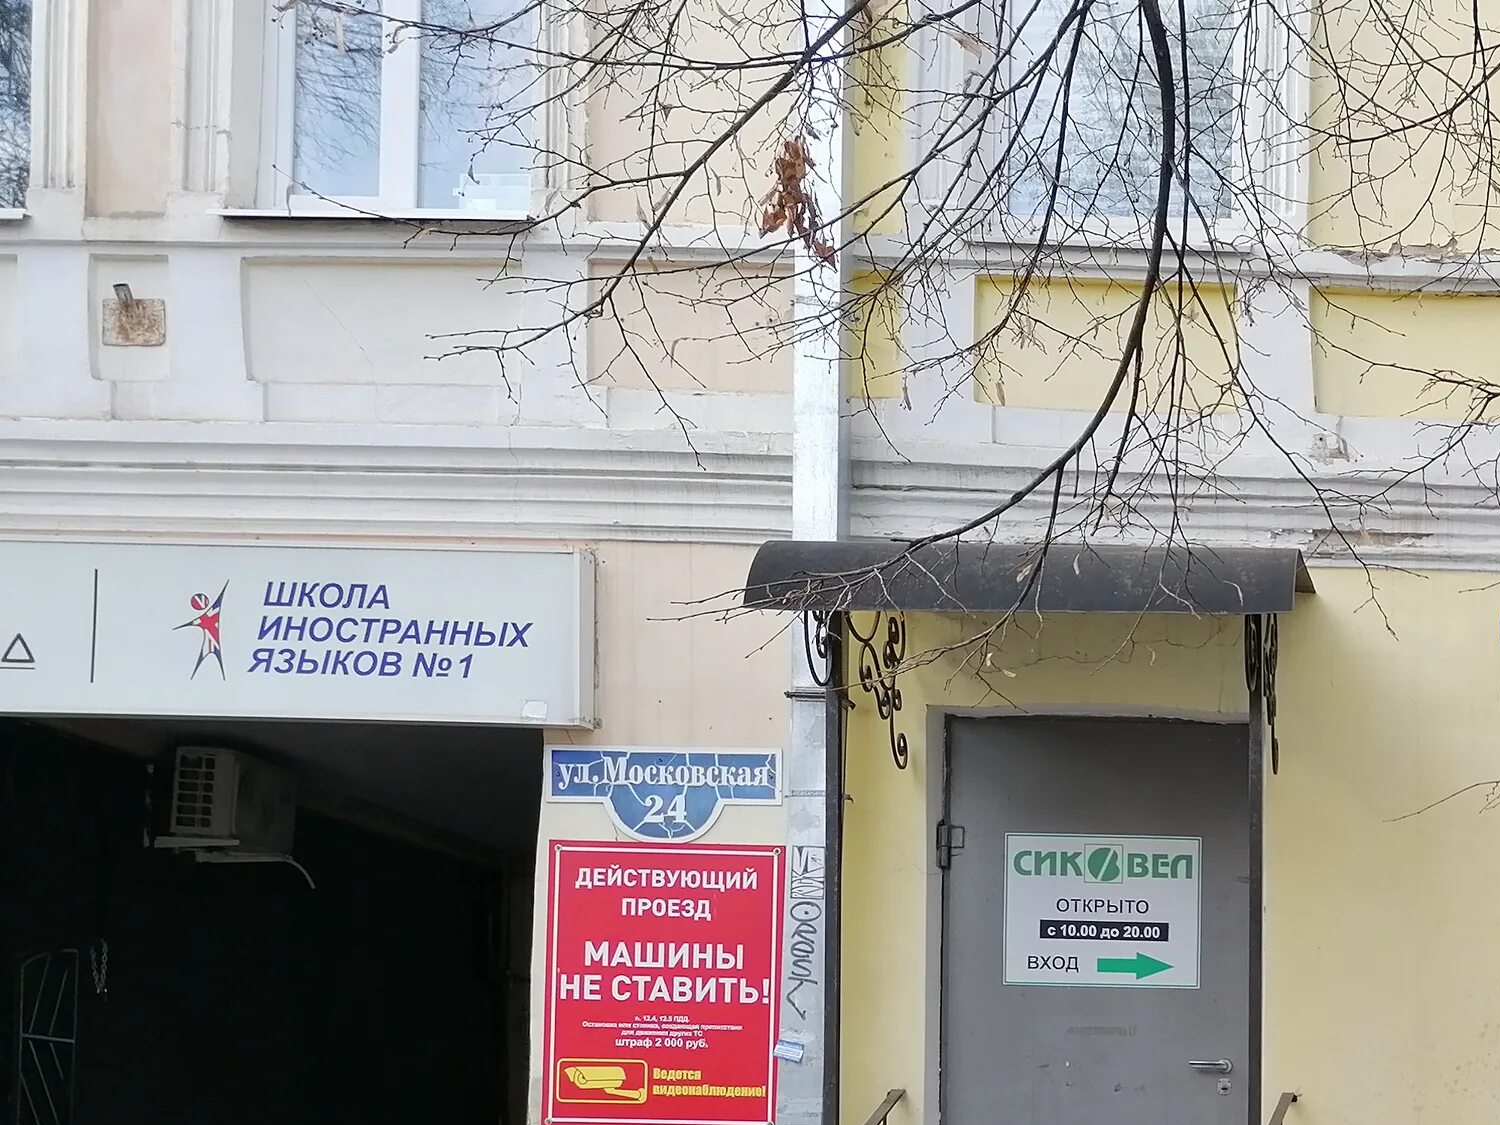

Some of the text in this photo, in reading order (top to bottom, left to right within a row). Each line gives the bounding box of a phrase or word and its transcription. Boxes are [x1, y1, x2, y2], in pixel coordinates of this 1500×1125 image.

[263, 581, 390, 609] ШКОЛА
[257, 616, 533, 648] ИНОСТРАННЫХ
[247, 648, 402, 677] ЯЗЫКОВ
[644, 794, 687, 823] 24
[575, 864, 758, 892] ДЕЙСТВУЮЩИЙ
[621, 898, 712, 921] ПРОЕЗД
[1056, 898, 1149, 914] ОТКРЫТО
[1047, 924, 1161, 940] с 10.00 до 20.00
[584, 941, 744, 970] МАШИНЫ
[1027, 955, 1079, 973] ВХОД
[559, 974, 770, 1004] НЕ СТАВИТЬ!
[615, 1038, 709, 1050] штраф 2 000 руб.
[653, 1068, 701, 1081] Ведется
[653, 1084, 766, 1098] видеонаблюдение!
